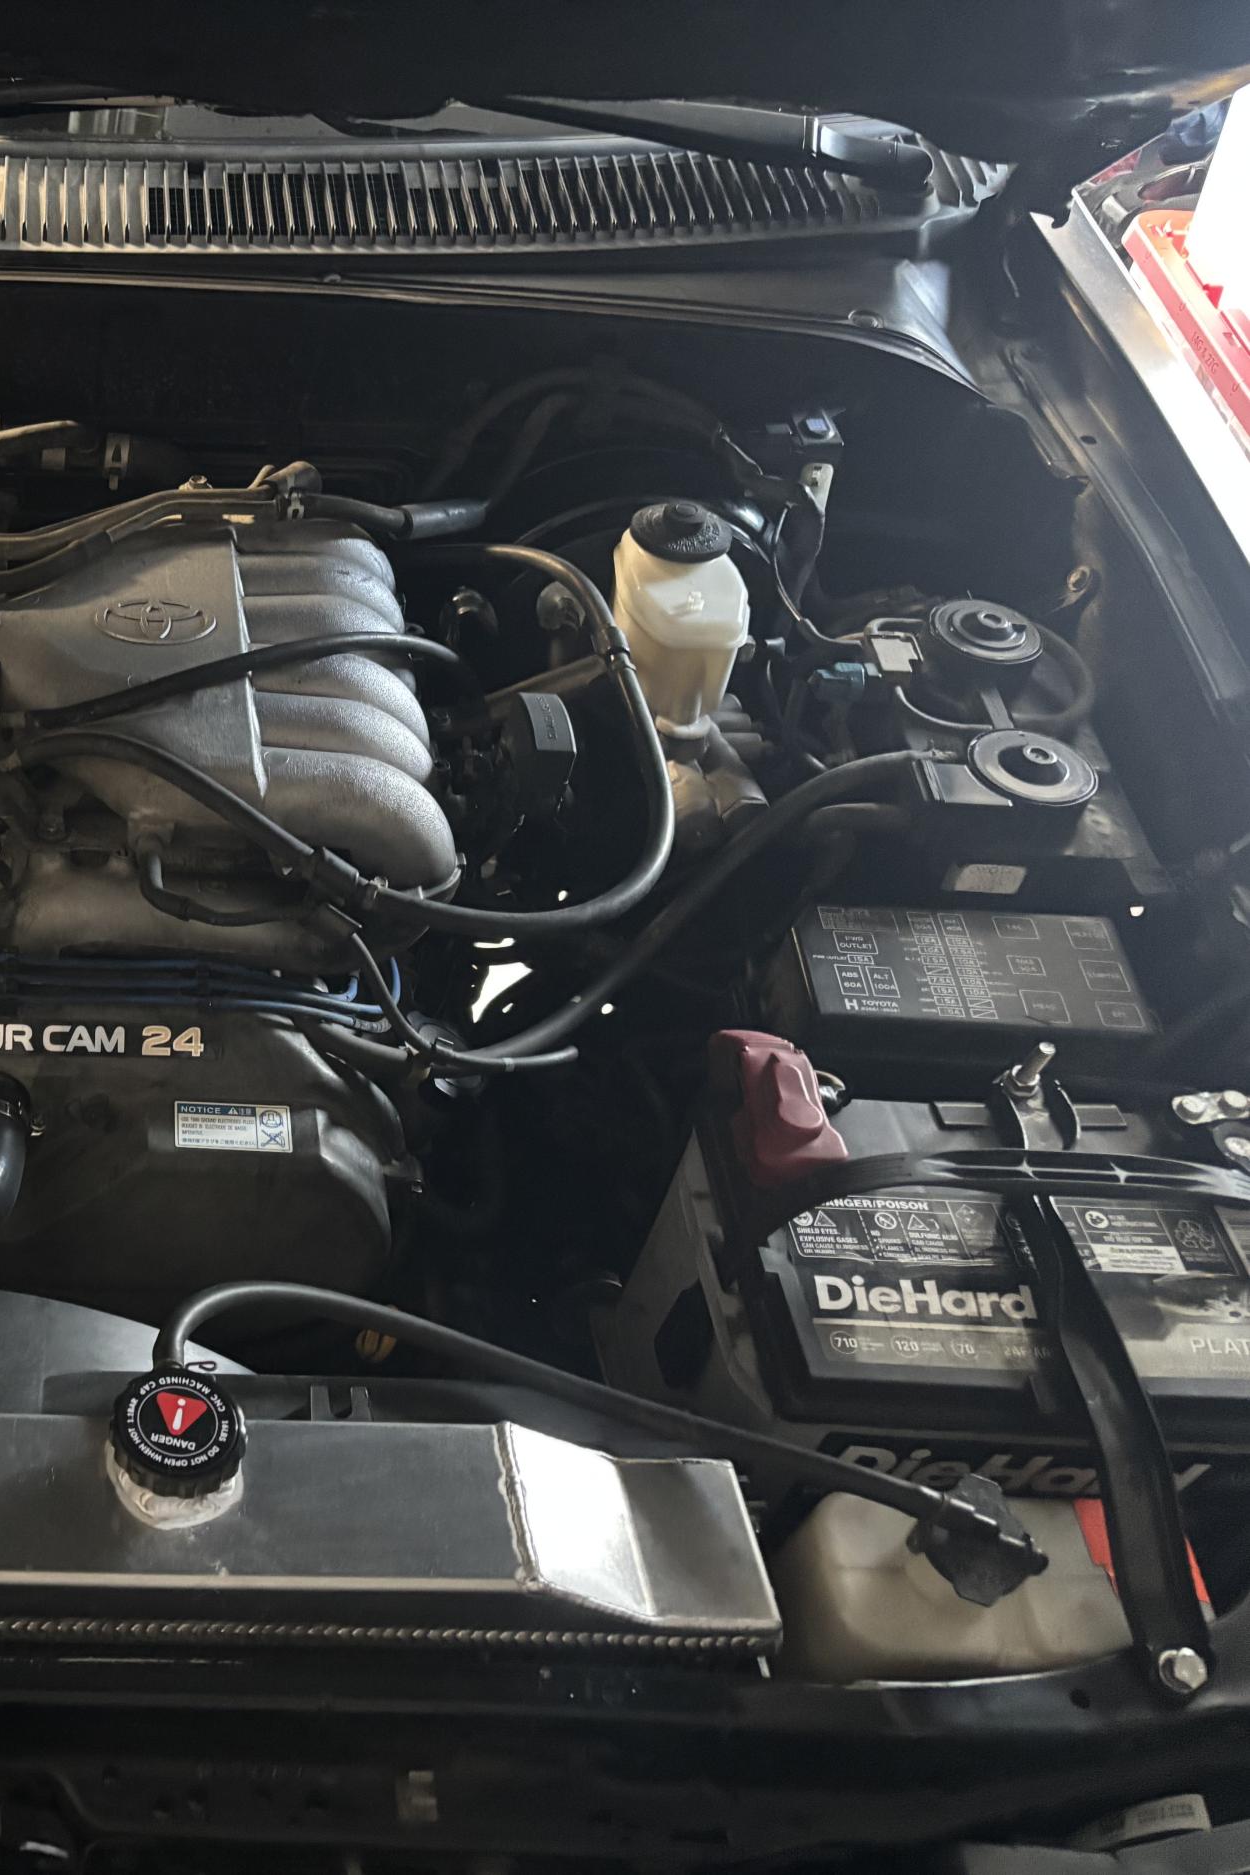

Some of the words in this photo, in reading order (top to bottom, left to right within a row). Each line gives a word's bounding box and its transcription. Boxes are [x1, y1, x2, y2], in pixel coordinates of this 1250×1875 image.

[861, 1000, 899, 1008] TOYOTA
[43, 1024, 126, 1054] CAM
[141, 1026, 204, 1057] 24
[180, 1105, 222, 1115] NOTICE
[822, 1198, 929, 1211] ANGER/POISON
[799, 1235, 836, 1243] EXPLOSIVE
[814, 1275, 1038, 1319] DieHard
[833, 1336, 858, 1348] 710
[895, 1339, 919, 1352] 120
[956, 1343, 975, 1354] 70
[139, 1381, 156, 1395] CAP
[158, 1376, 211, 1395] MACHINED
[210, 1393, 226, 1413] CNC
[150, 1432, 196, 1451] DANGER
[138, 1442, 163, 1463] WHEN
[207, 1445, 220, 1458] DO
[163, 1457, 188, 1467] OPEN
[190, 1455, 208, 1467] NOT
